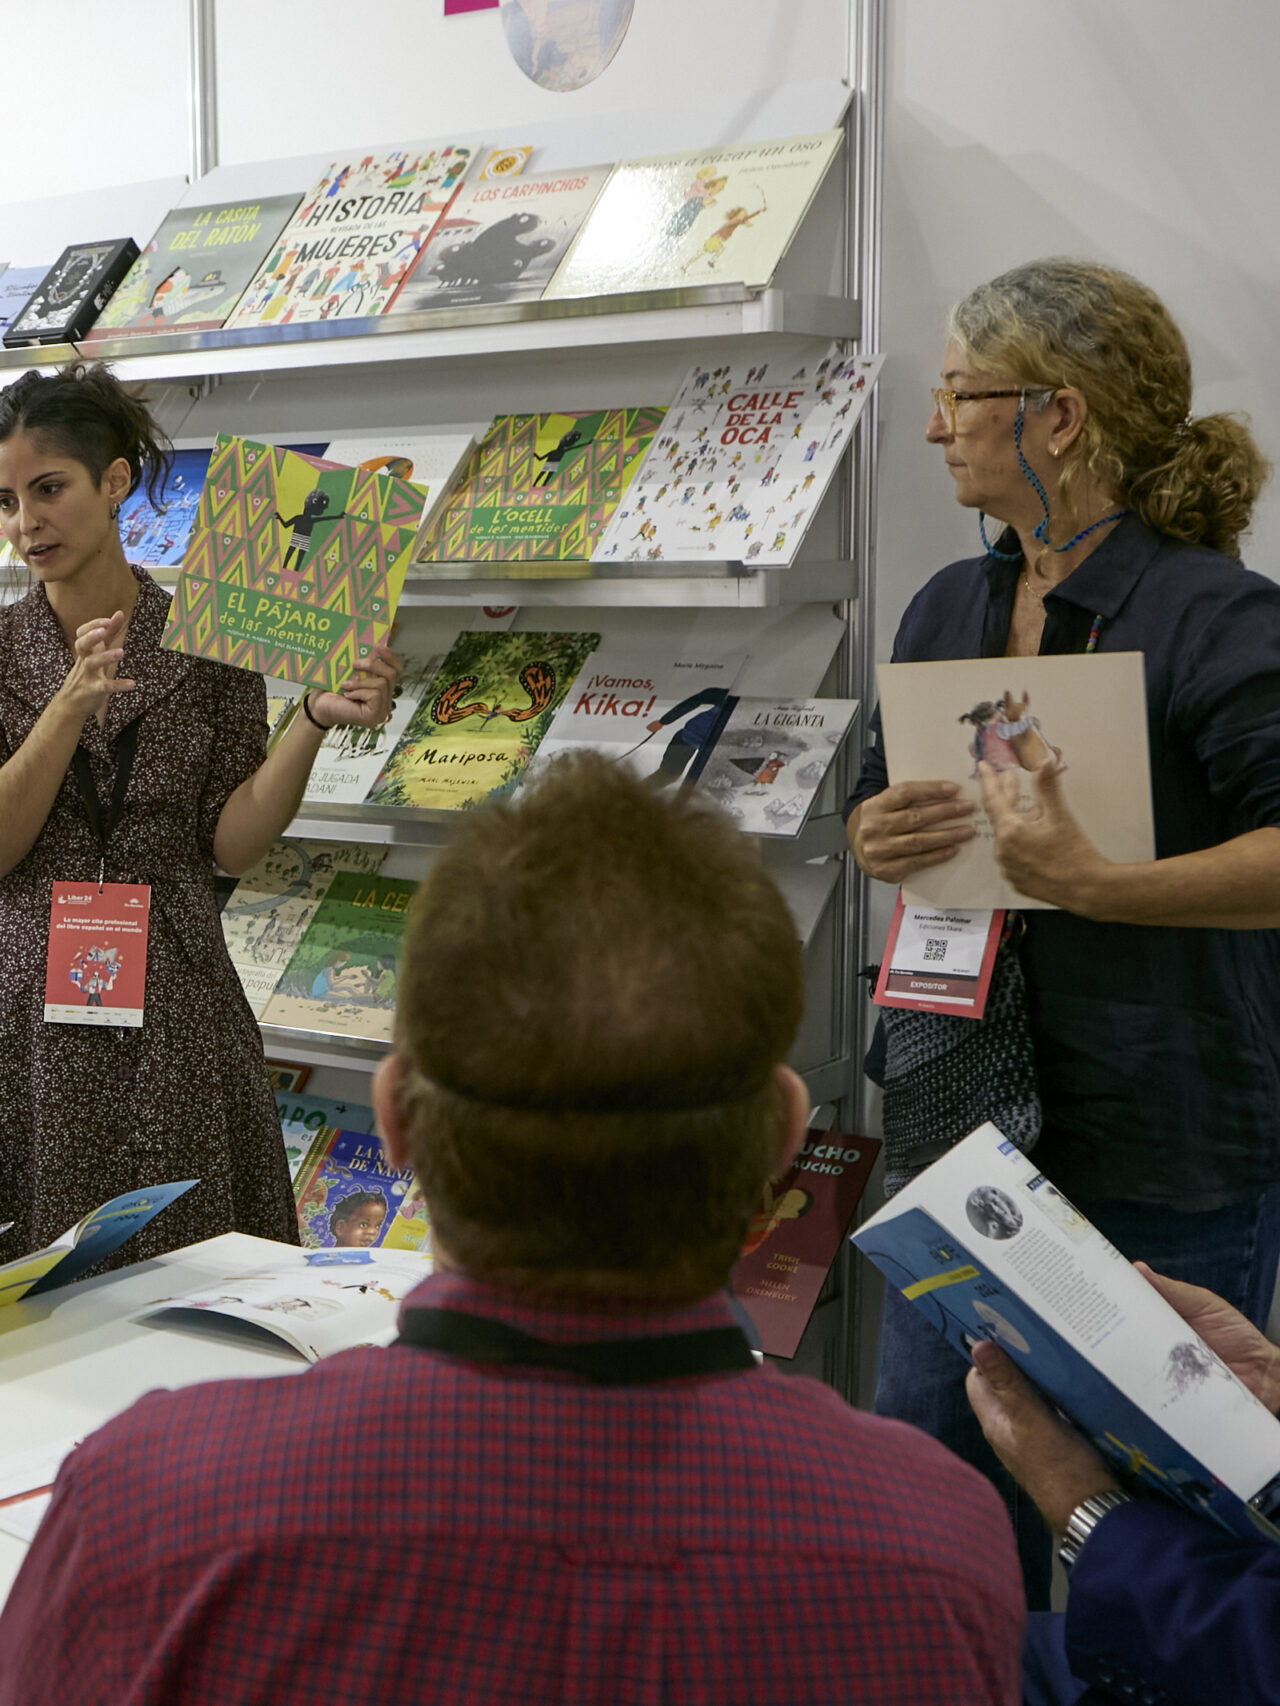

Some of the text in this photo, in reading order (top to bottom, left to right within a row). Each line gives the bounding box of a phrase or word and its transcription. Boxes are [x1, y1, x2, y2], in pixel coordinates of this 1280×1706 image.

[701, 150, 757, 165] cazar
[758, 145, 785, 158] un
[789, 140, 823, 154] oso
[472, 176, 589, 203] LOS CARPINCHOS
[192, 205, 260, 227] LA CASITA
[305, 191, 426, 227] HISTORIA
[168, 219, 262, 250] DEL RATÓN
[294, 230, 404, 264] MUJERES
[726, 391, 805, 412] CALLE
[724, 412, 783, 427] DE LA
[720, 427, 773, 446] OCA
[492, 508, 553, 524] L'OCELL
[470, 523, 567, 535] de les mentides
[227, 592, 247, 613] EL
[219, 611, 236, 626] de
[241, 617, 263, 632] las
[586, 673, 656, 692] ¡Vamos,
[572, 692, 658, 718] Kika!
[753, 713, 825, 728] LA GIGANTA
[414, 748, 509, 771] Mariposa
[319, 773, 361, 785] JUGADA
[352, 889, 377, 908] LA
[245, 979, 274, 991] popu
[910, 981, 948, 991] EXPOSITOR
[279, 1104, 327, 1131] APO
[354, 1144, 373, 1159] LA
[799, 1143, 861, 1163] UCHO
[348, 1158, 370, 1172] DE
[371, 1161, 417, 1181] NAND
